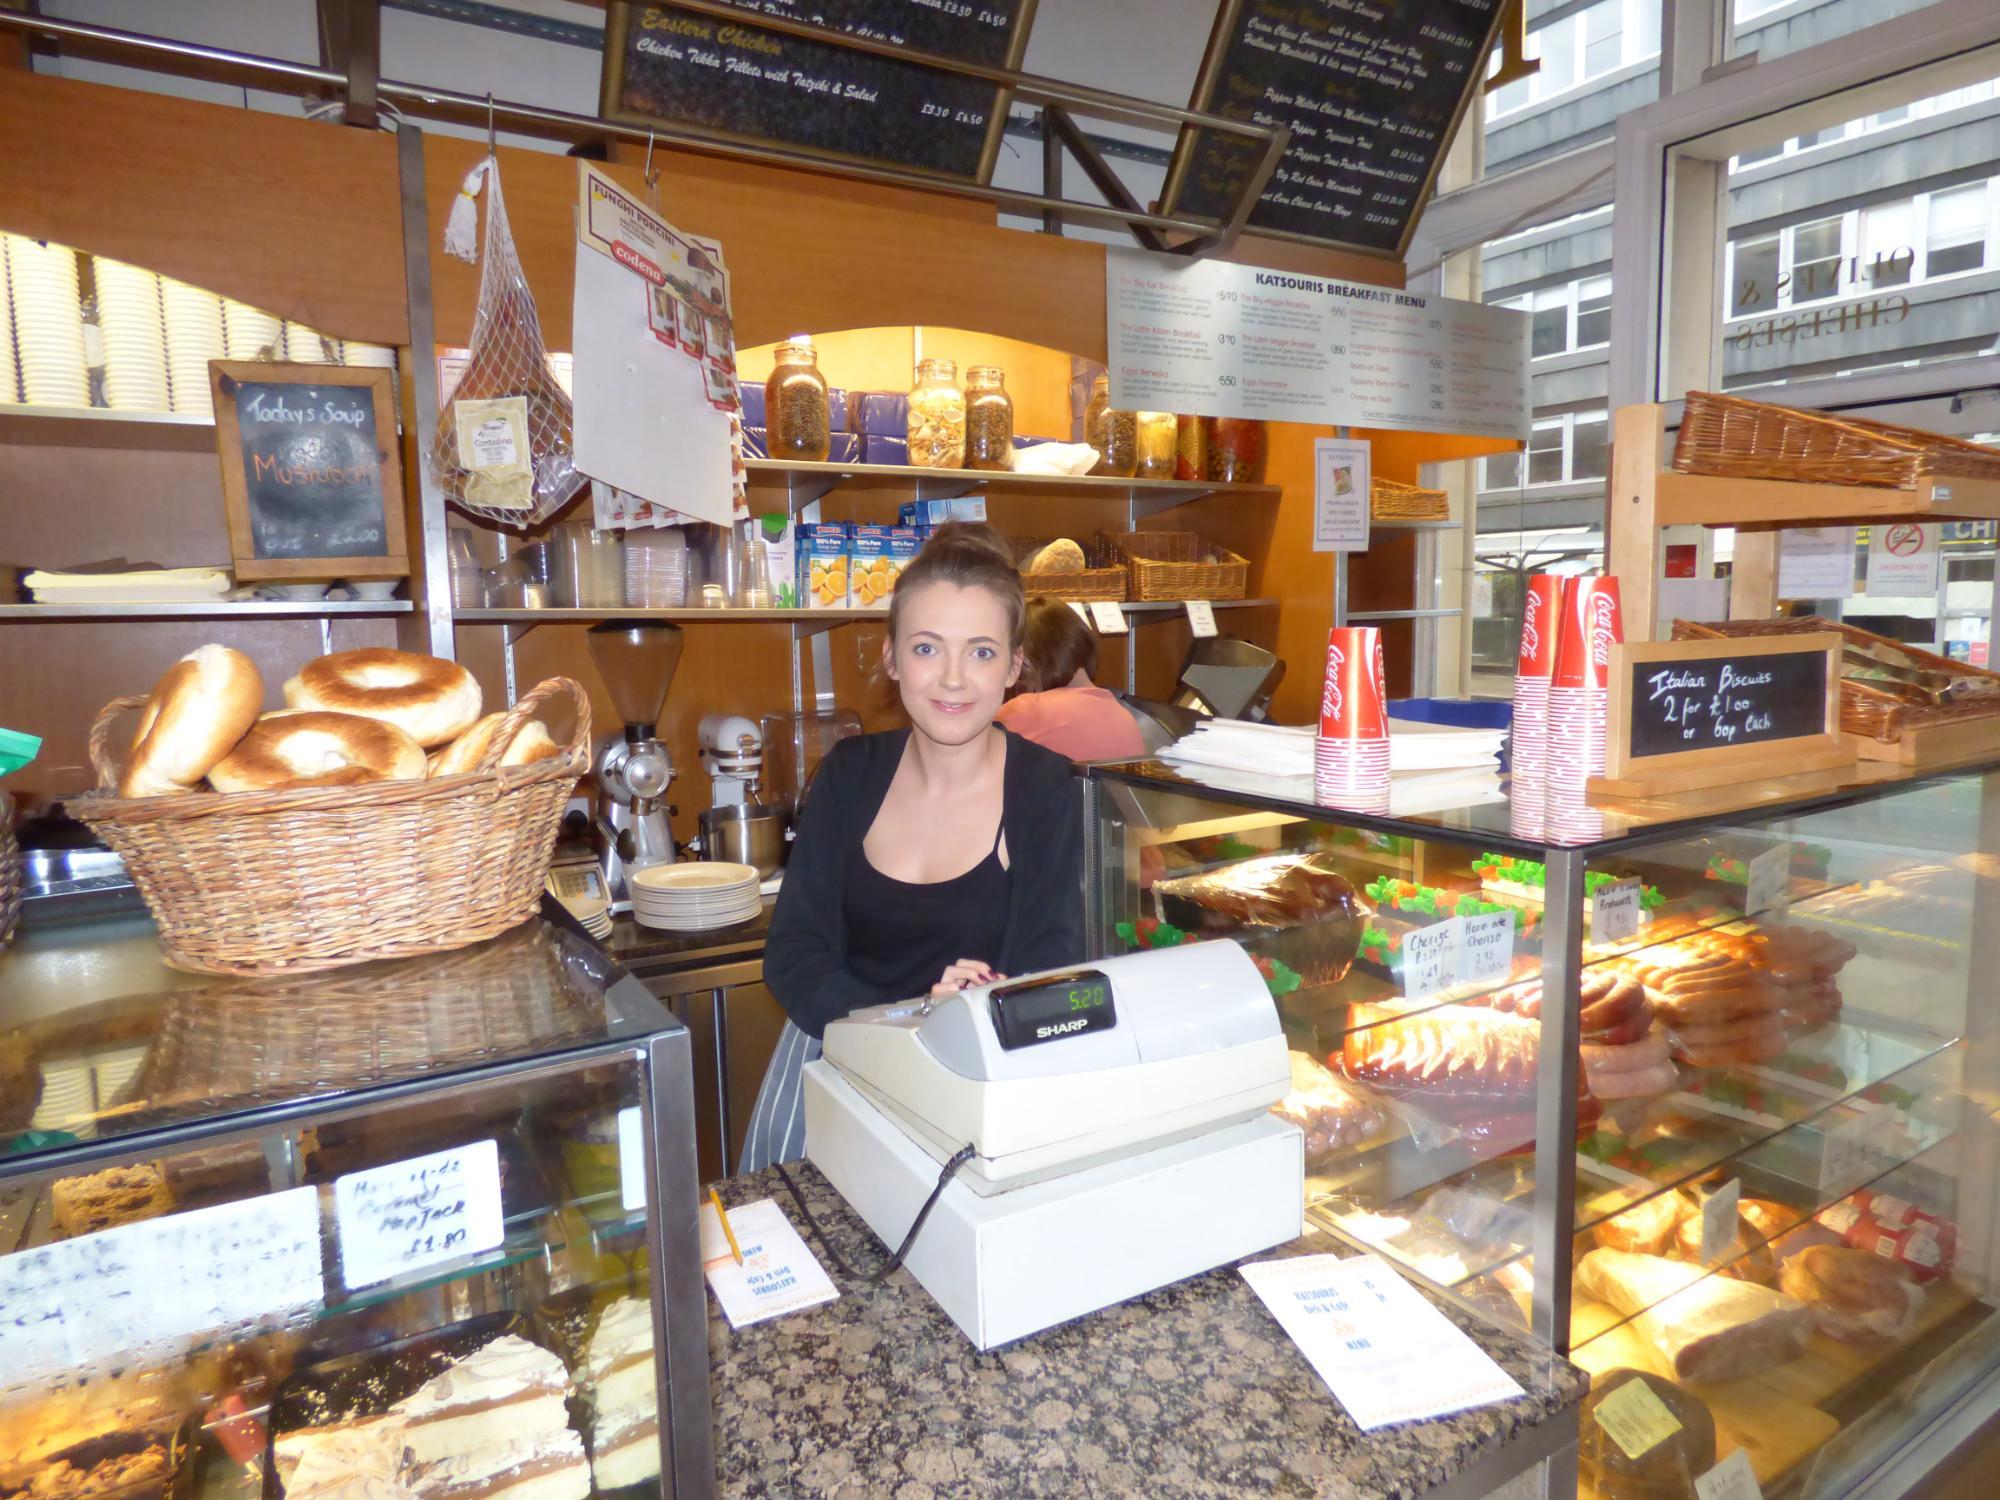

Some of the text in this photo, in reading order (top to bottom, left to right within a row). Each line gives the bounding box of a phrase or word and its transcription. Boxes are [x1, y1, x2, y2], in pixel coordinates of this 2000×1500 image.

[641, 7, 711, 40] Eastern
[716, 26, 782, 55] Chicken
[636, 38, 879, 103] Chicken Tikka Fillets with Tatziki & Salad
[594, 183, 635, 218] FUNGHI
[636, 211, 676, 247] PORCINI
[615, 244, 662, 282] codena
[1255, 272, 1426, 308] KATSOURIS BREAKFAST MENU
[319, 401, 366, 430] Soup
[1649, 665, 1772, 700] Italian Biscuits
[1664, 695, 1678, 722] 2
[1682, 697, 1701, 726] for
[1683, 727, 1695, 739] or
[1714, 716, 1736, 742] 60p
[1069, 987, 1104, 1010] 5.20
[1036, 1019, 1088, 1038] SHARP
[752, 1275, 797, 1297] KATSOURIS
[1345, 1337, 1372, 1351] MENU
